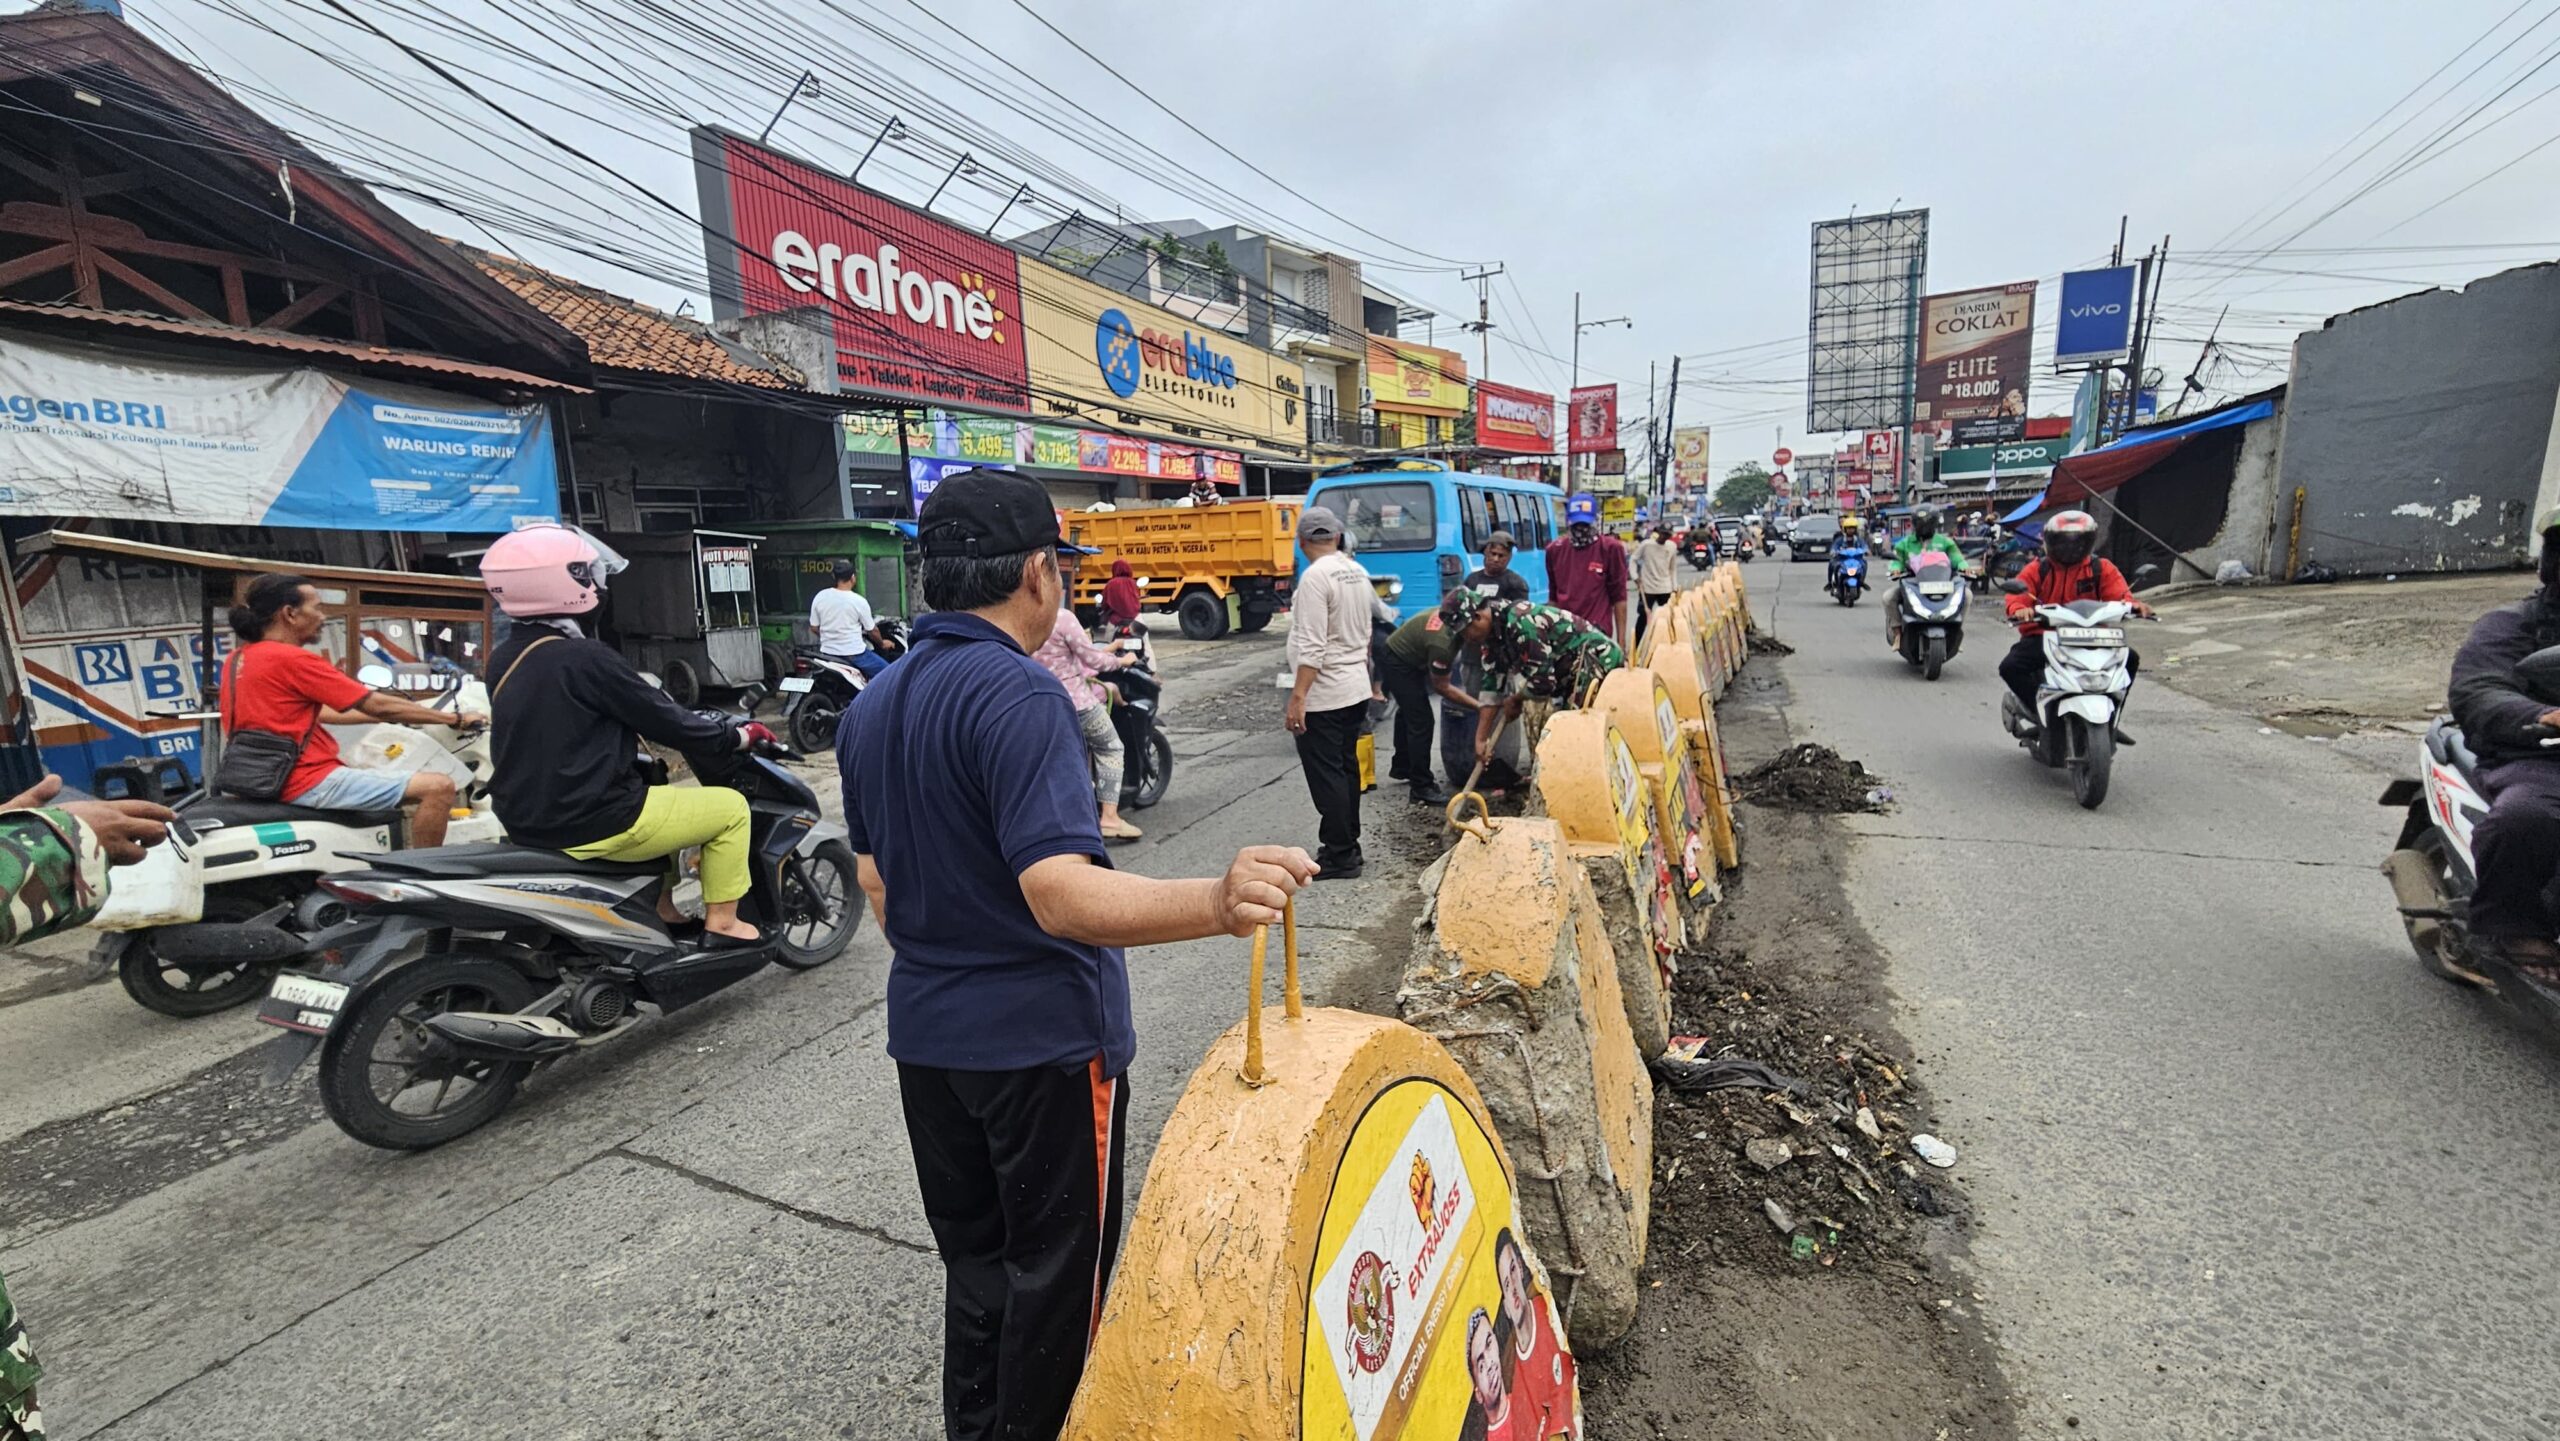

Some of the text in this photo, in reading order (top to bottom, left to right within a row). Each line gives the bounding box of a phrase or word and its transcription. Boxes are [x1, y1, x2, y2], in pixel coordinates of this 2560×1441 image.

[772, 230, 996, 340] erafone
[1954, 301, 2000, 315] DJARUM
[2070, 304, 2121, 318] vivo
[1936, 310, 2020, 334] COKLAT
[1141, 327, 1237, 390] erablue
[1948, 356, 1998, 379] ELITE
[869, 366, 912, 387] Tablet
[923, 376, 965, 397] Laptop
[1145, 374, 1236, 409] ELECTRONICS
[46, 424, 108, 440] Transaksi
[112, 432, 178, 447] Keuangan
[182, 437, 217, 451] Tanpa
[383, 436, 466, 457] WARUNG
[1993, 447, 2047, 463] oppo
[158, 736, 195, 755] BRI
[274, 841, 311, 856] Fazzio
[1407, 1176, 1461, 1300] EXTRAJOSS
[1399, 1336, 1428, 1401] OFFICIAL
[1425, 1286, 1448, 1339] ENERGY
